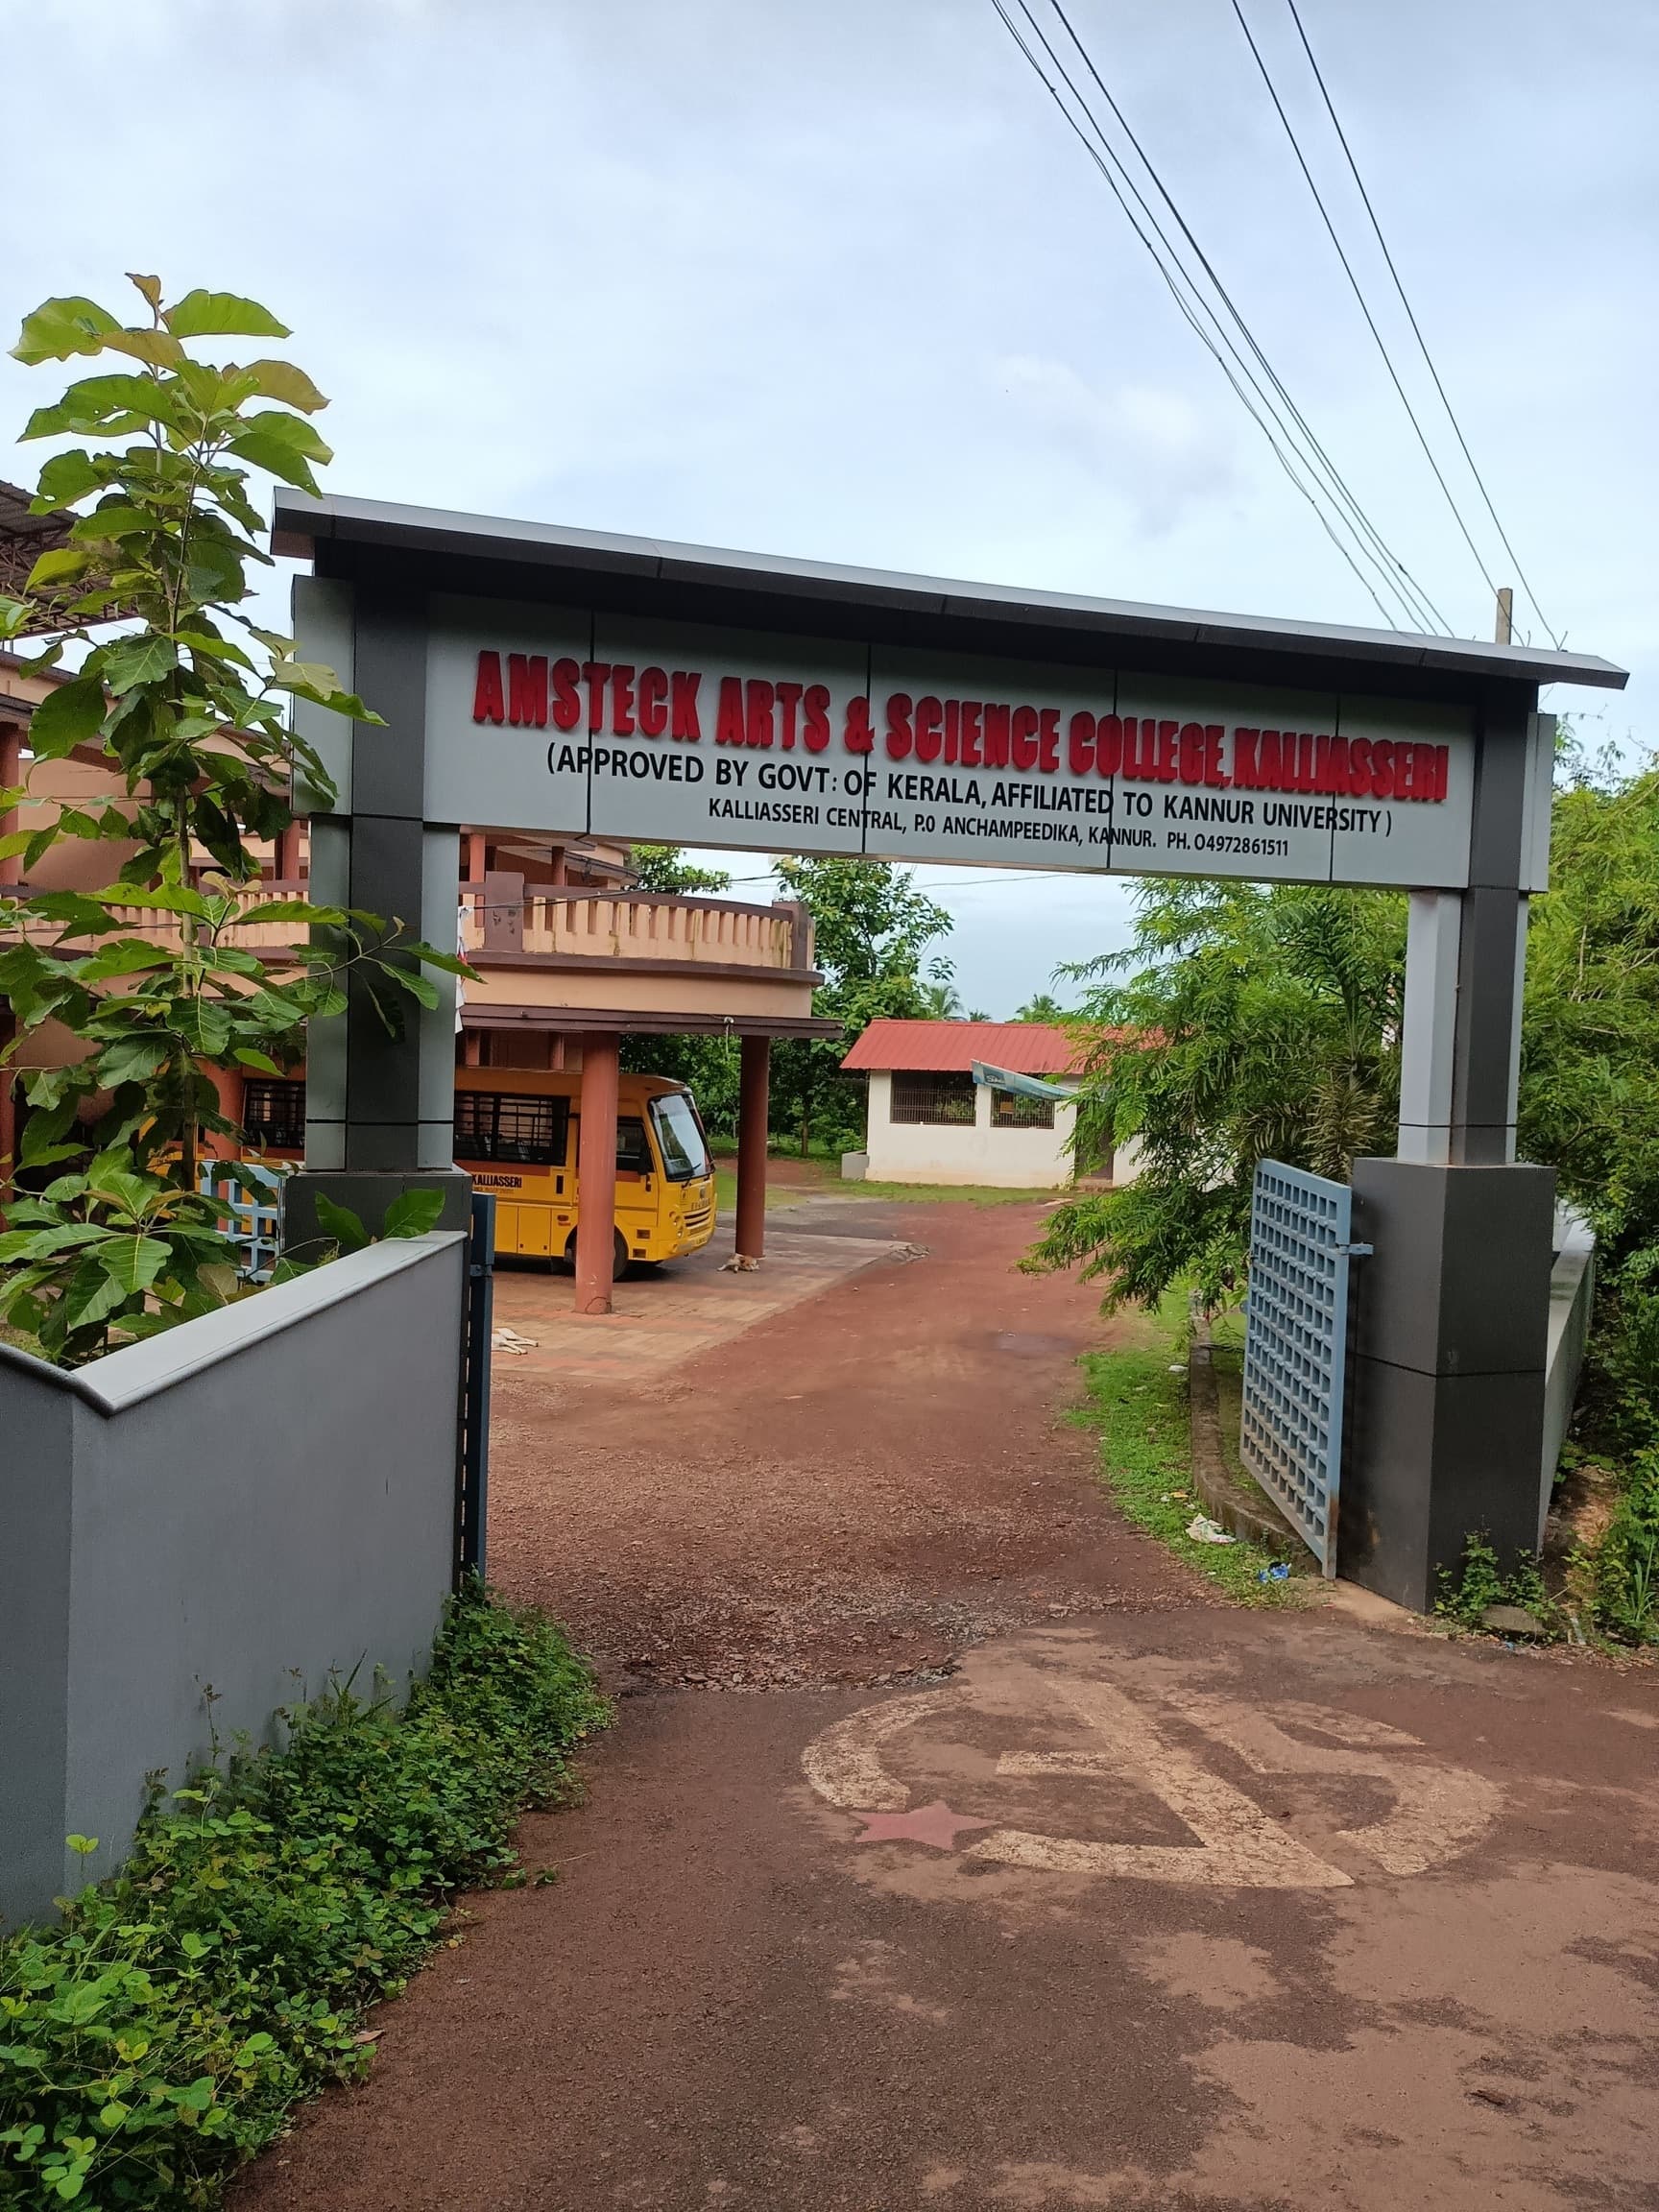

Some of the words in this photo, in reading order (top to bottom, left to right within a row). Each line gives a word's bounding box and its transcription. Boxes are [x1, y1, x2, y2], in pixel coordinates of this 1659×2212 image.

[473, 650, 702, 739] AMSTECK
[714, 676, 831, 753] ARTS
[844, 695, 875, 754] &
[886, 692, 1061, 772] SCIENCE
[546, 742, 704, 783] (APPROVED
[715, 759, 749, 786] BY
[843, 771, 878, 797] OF
[887, 774, 989, 806] KERALA,
[991, 781, 1114, 814] AFFILIATED
[1122, 792, 1153, 817] TO
[1164, 795, 1255, 825] KANNUR
[709, 798, 820, 825] KALLIASSERI
[827, 806, 907, 834] CENTRAL,
[942, 816, 1083, 847] ANCHAMPEEDIKA,
[1088, 827, 1157, 848] KANNUR.
